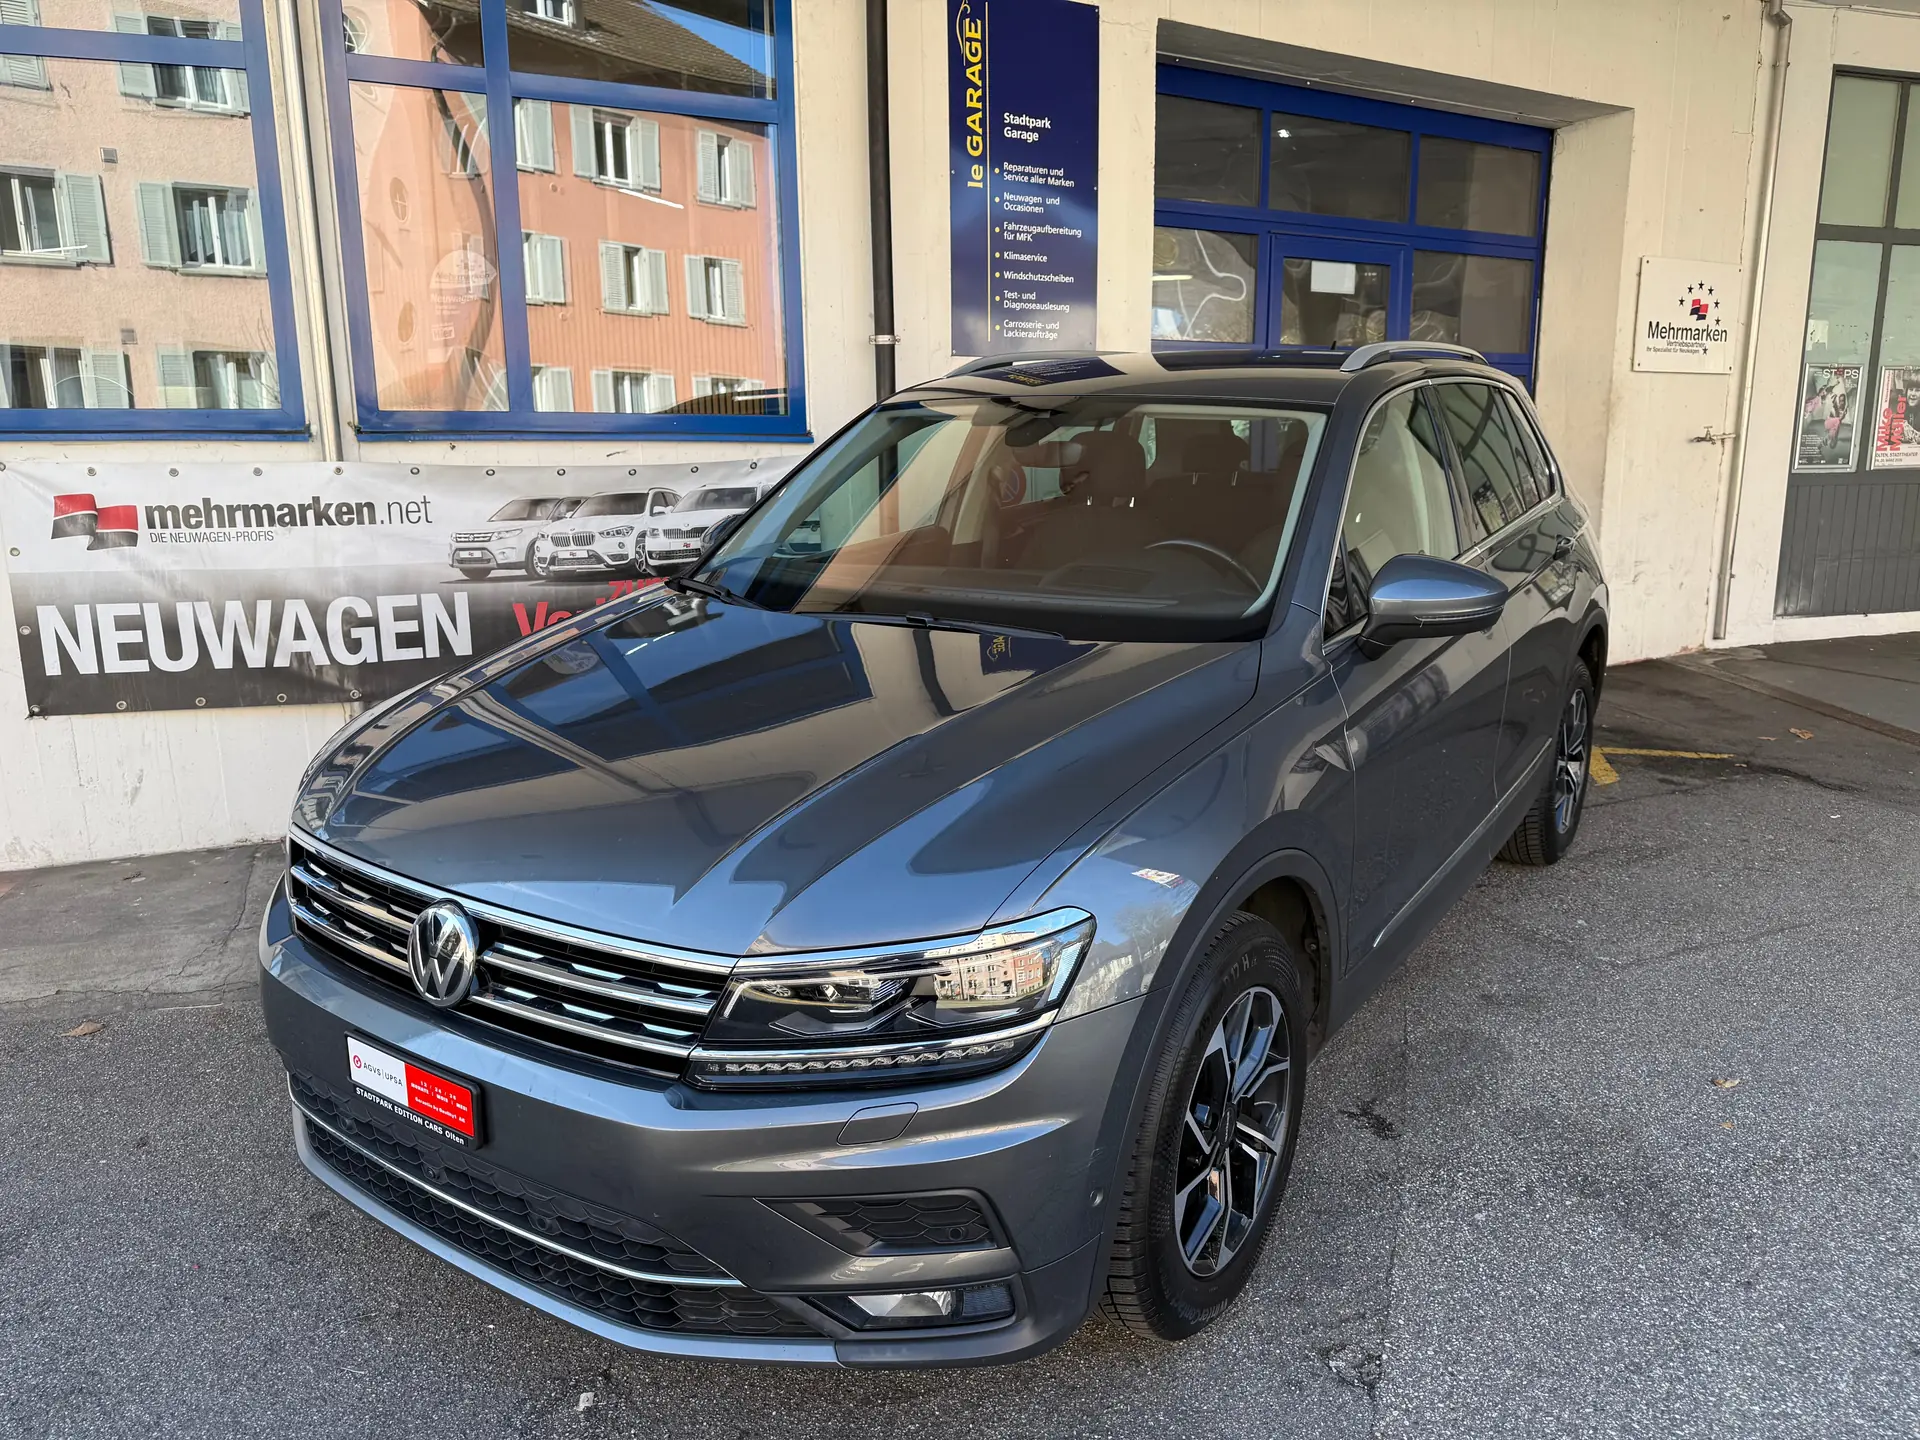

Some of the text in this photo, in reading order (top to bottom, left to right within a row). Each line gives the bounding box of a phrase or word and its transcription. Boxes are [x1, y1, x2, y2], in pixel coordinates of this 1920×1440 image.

[965, 17, 983, 188] le GARAGE
[1003, 112, 1051, 129] Stadtpark
[1003, 127, 1039, 143] Garage
[1003, 161, 1063, 176] Reparaturen und
[1003, 172, 1075, 188] Service aller Marken
[1003, 191, 1060, 206] Neuwagen und
[1003, 202, 1044, 214] Occasionen
[1003, 221, 1082, 238] Fahrzeugaufbereitung
[1003, 231, 1033, 242] für MFK
[1003, 250, 1048, 263] Klimaservice
[1003, 270, 1074, 283] Windschutzscheiben
[1003, 290, 1036, 300] Test- und
[1003, 299, 1070, 313] Diagnoseauslesung
[1003, 319, 1060, 330] Carrosserie- und
[1647, 320, 1728, 342] Mehrmarken
[1003, 329, 1058, 341] Lackieraufträge
[144, 494, 433, 531] mehrmarken.net
[149, 530, 275, 543] DIE NEUWAGEN-PROFIS
[35, 591, 473, 677] NEUWAGEN
[363, 1062, 403, 1087] AGVS UPSA
[355, 1086, 465, 1145] STADTPARK EDITION CARS Olten
